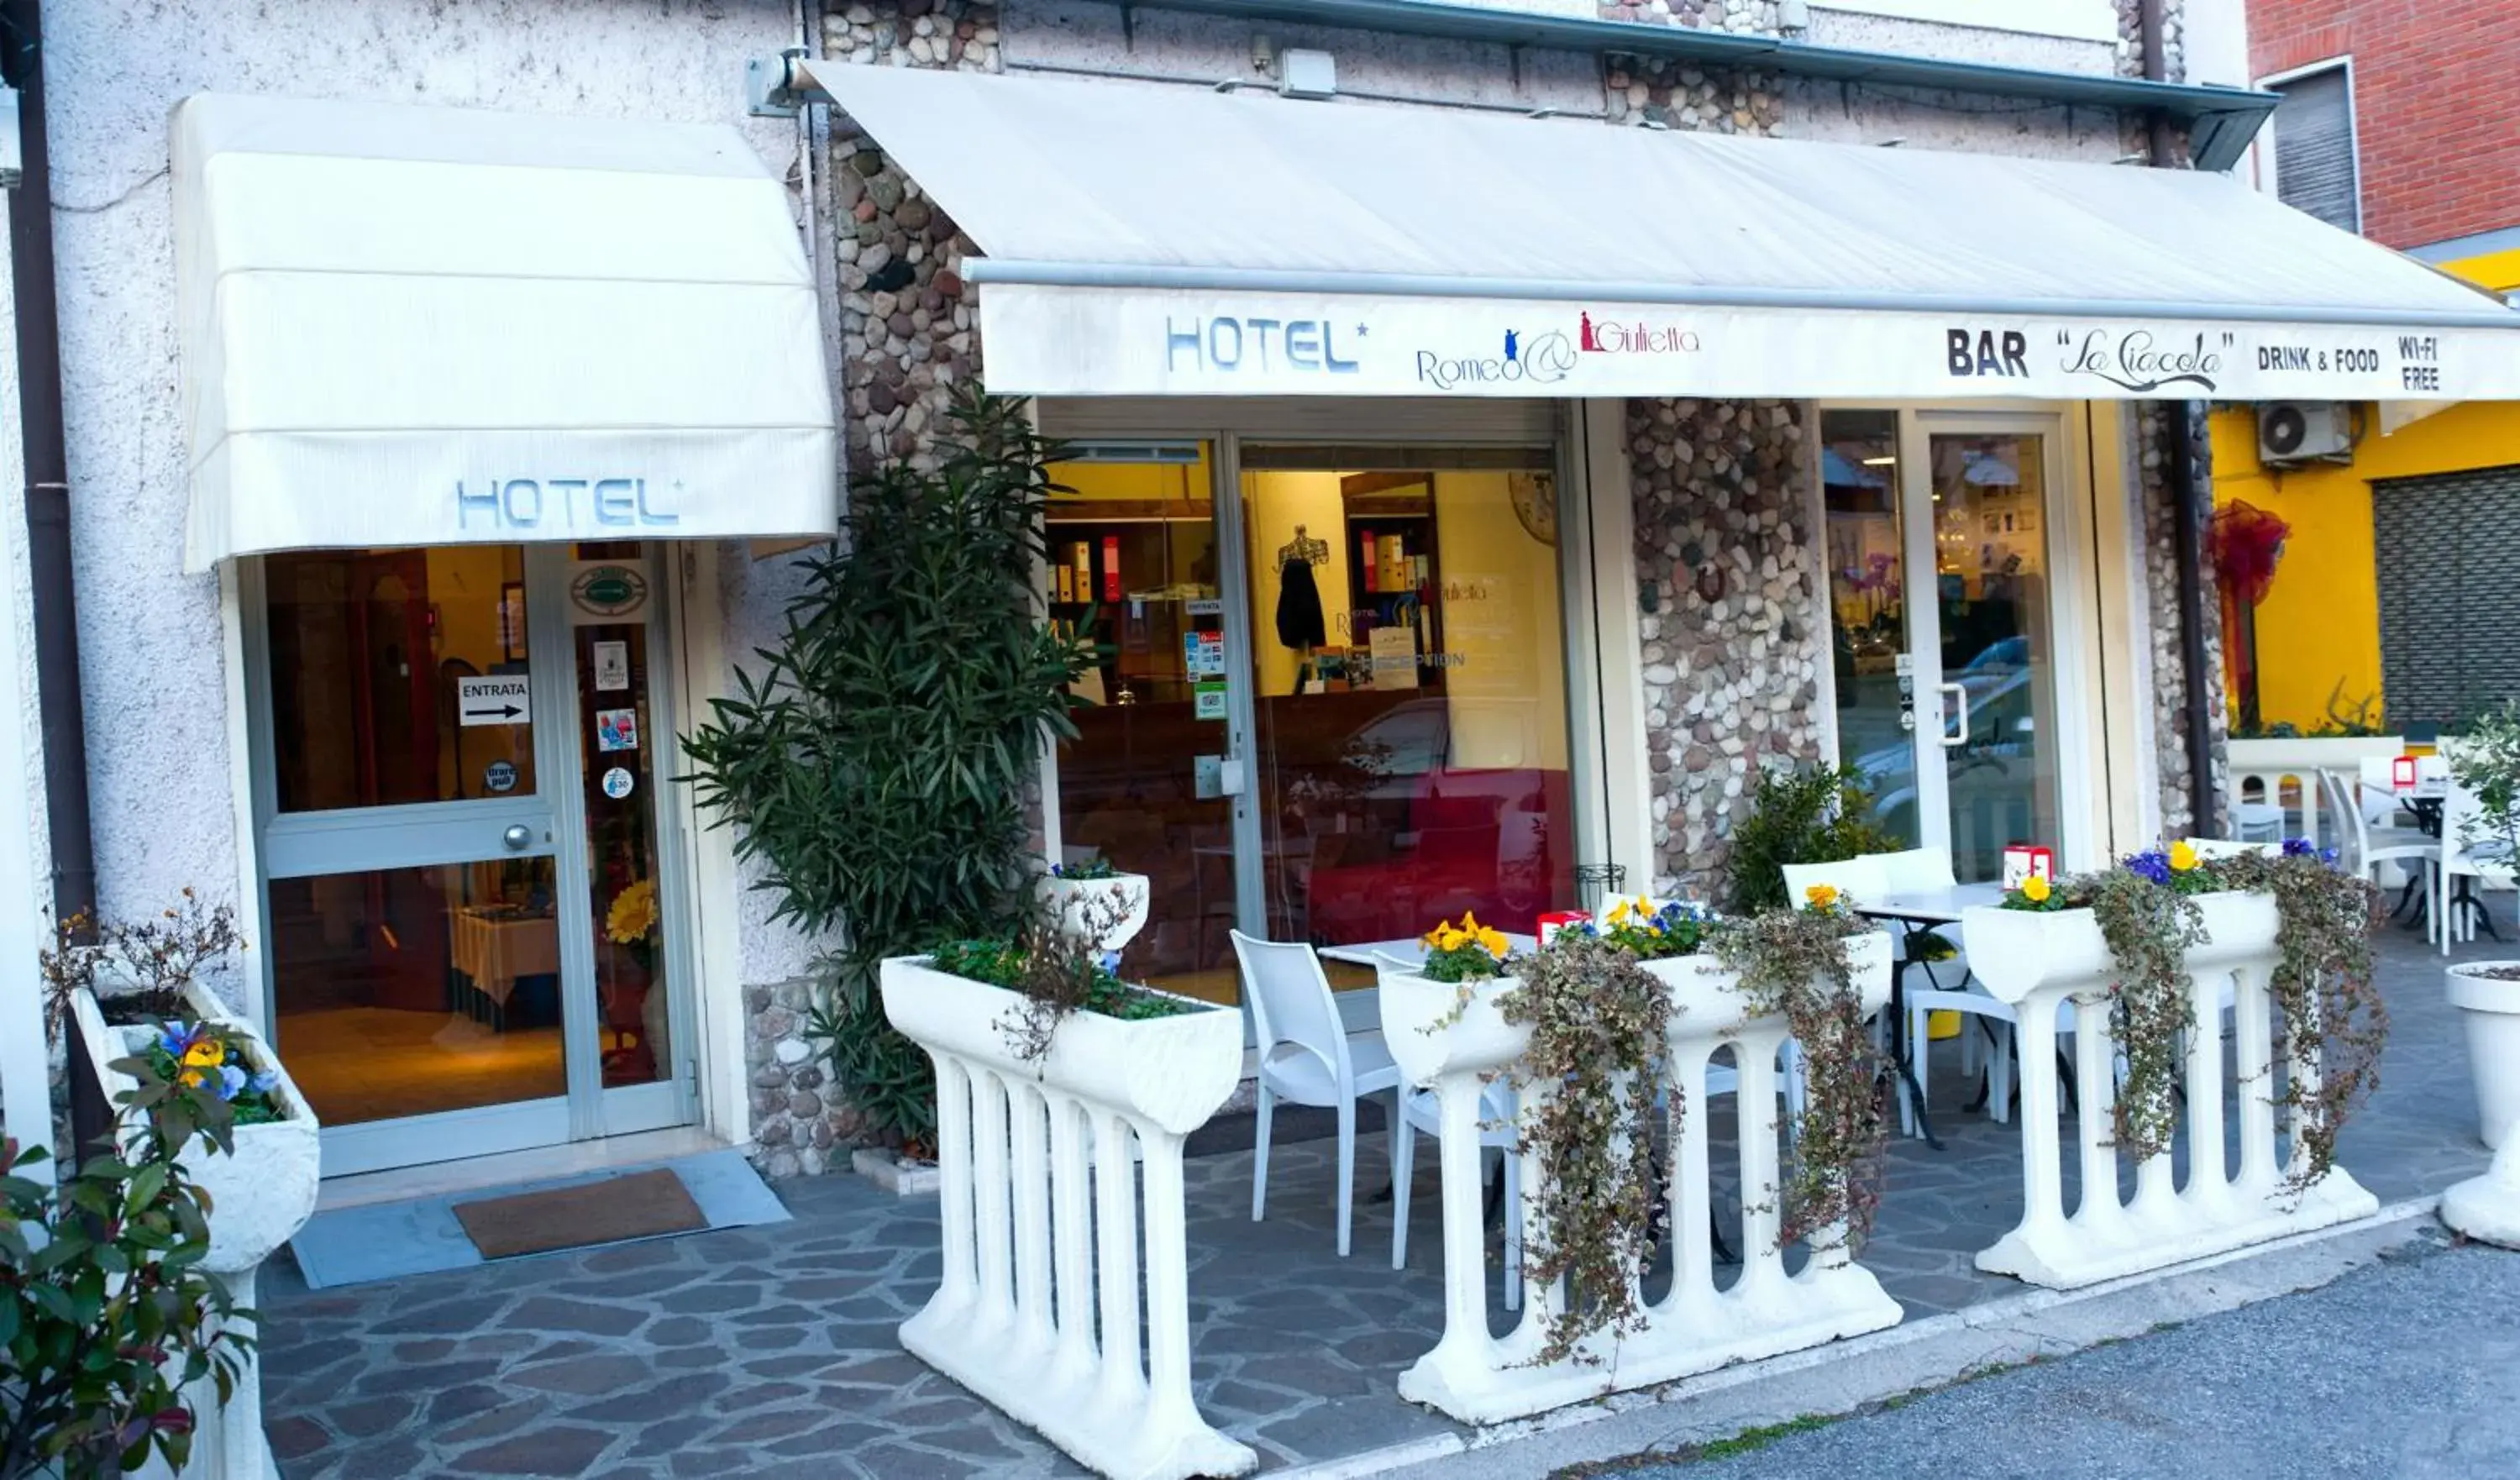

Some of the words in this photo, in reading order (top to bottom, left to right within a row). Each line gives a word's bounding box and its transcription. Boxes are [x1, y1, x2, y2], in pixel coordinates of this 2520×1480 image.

[1167, 315, 1360, 373] HOTEL
[1416, 350, 1523, 390] Romeo
[1593, 321, 1700, 354] Giulietta
[1946, 328, 2029, 378] BAR
[2258, 346, 2311, 372] DRINK
[2318, 350, 2328, 371] &
[2336, 348, 2379, 372] FOOD
[2398, 336, 2438, 361] WI-FI
[2402, 366, 2439, 391] FREE
[457, 478, 680, 530] HOTEL
[463, 683, 528, 697] ENTRATA
